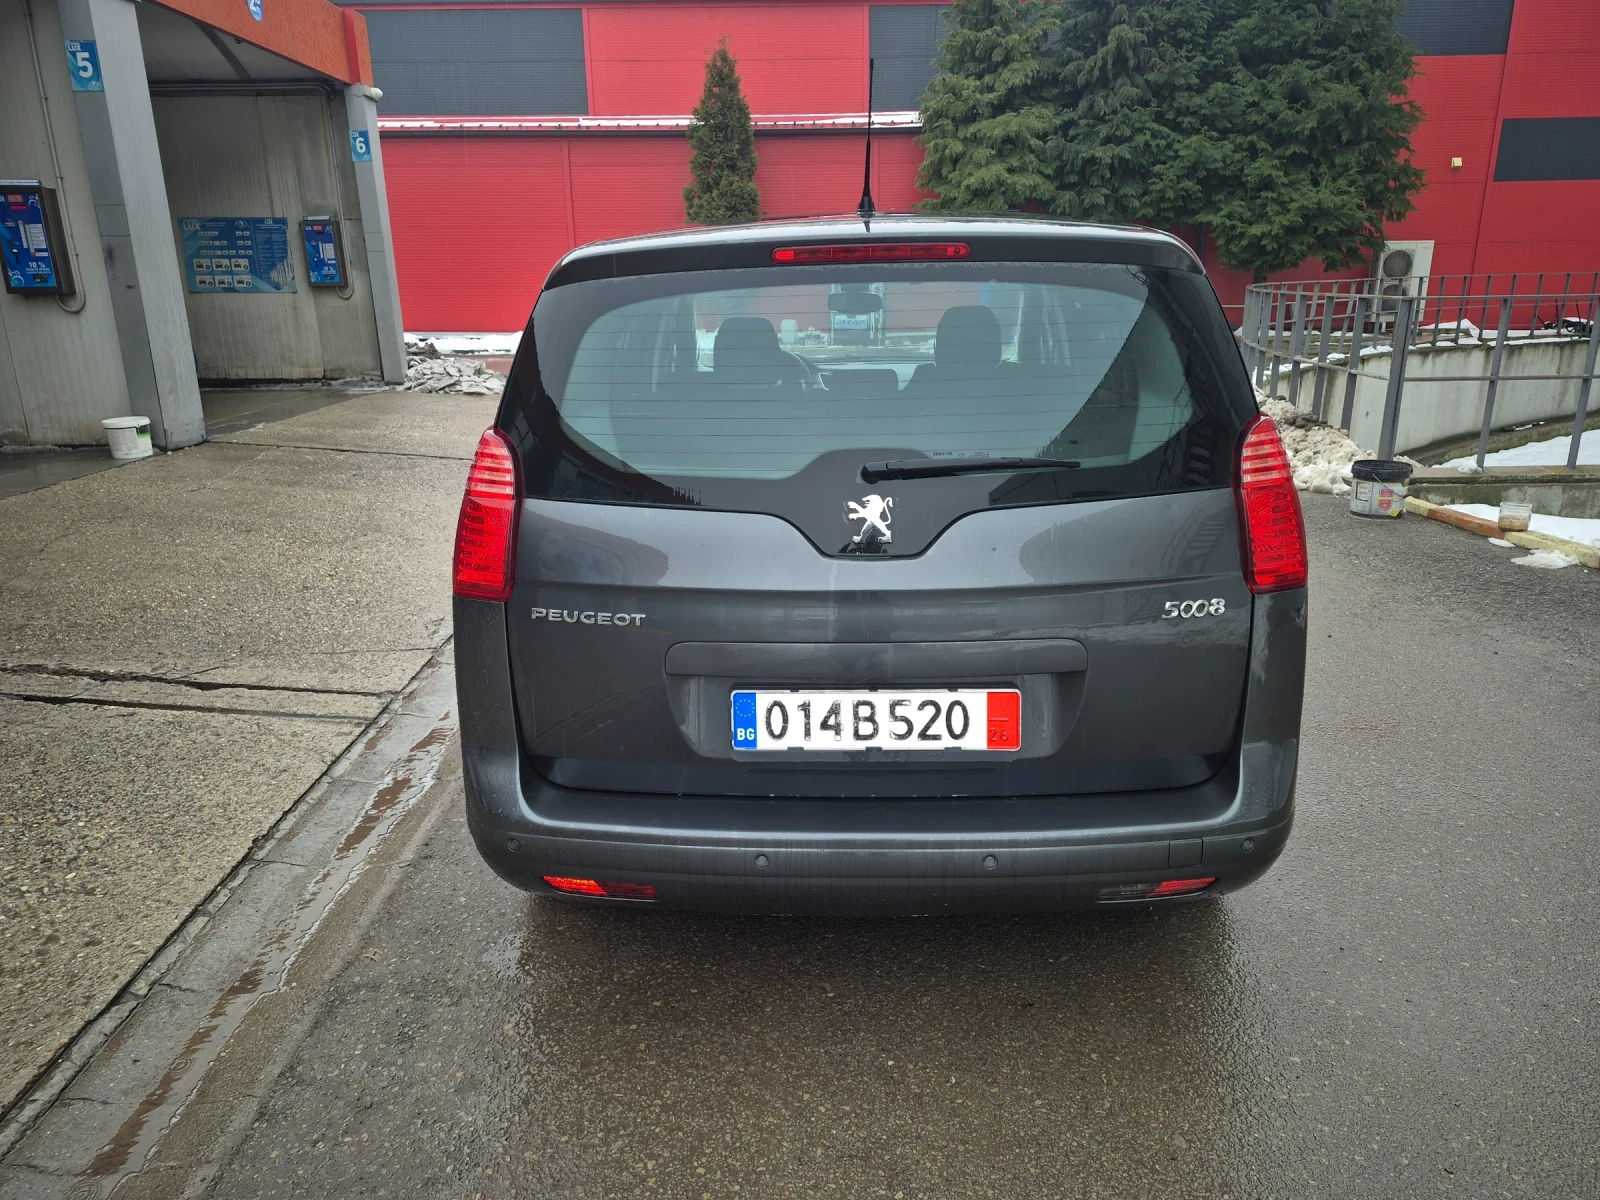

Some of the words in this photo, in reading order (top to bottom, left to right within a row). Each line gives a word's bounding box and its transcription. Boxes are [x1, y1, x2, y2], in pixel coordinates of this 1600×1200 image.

[67, 43, 82, 51] LUX
[76, 52, 93, 78] 5
[356, 137, 366, 153] 6
[183, 221, 201, 231] LUX
[1161, 598, 1226, 619] 5008
[531, 607, 646, 626] PEUGEOT
[736, 728, 755, 740] BG
[989, 727, 1009, 742] 26
